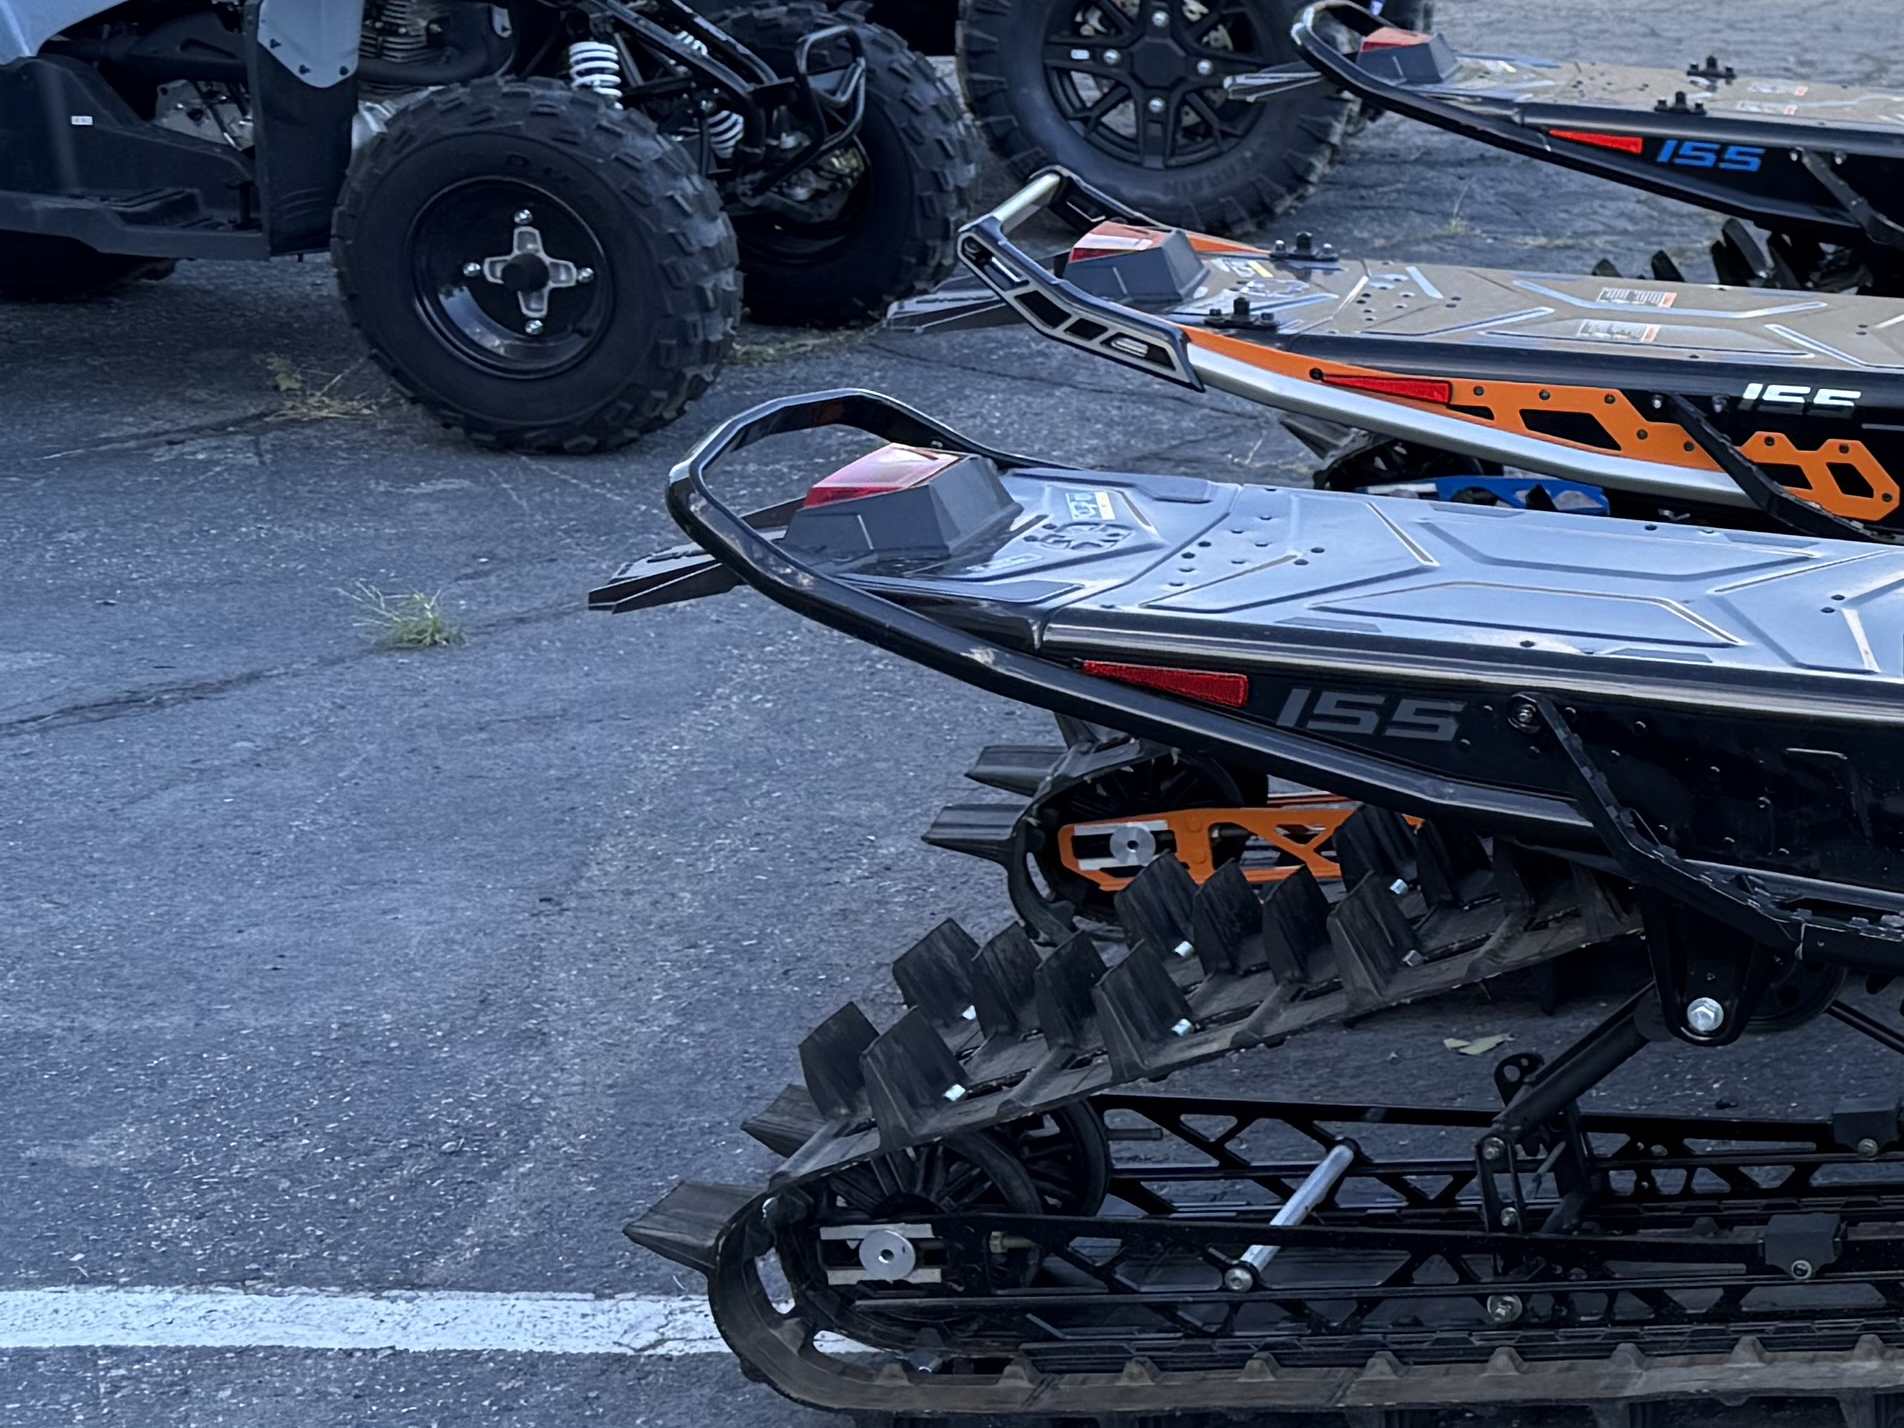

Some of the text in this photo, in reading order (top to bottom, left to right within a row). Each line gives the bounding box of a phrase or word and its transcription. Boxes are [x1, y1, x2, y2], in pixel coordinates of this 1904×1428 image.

[1656, 139, 1766, 172] 155
[1739, 382, 1862, 417] 155
[1276, 687, 1468, 742] 155
